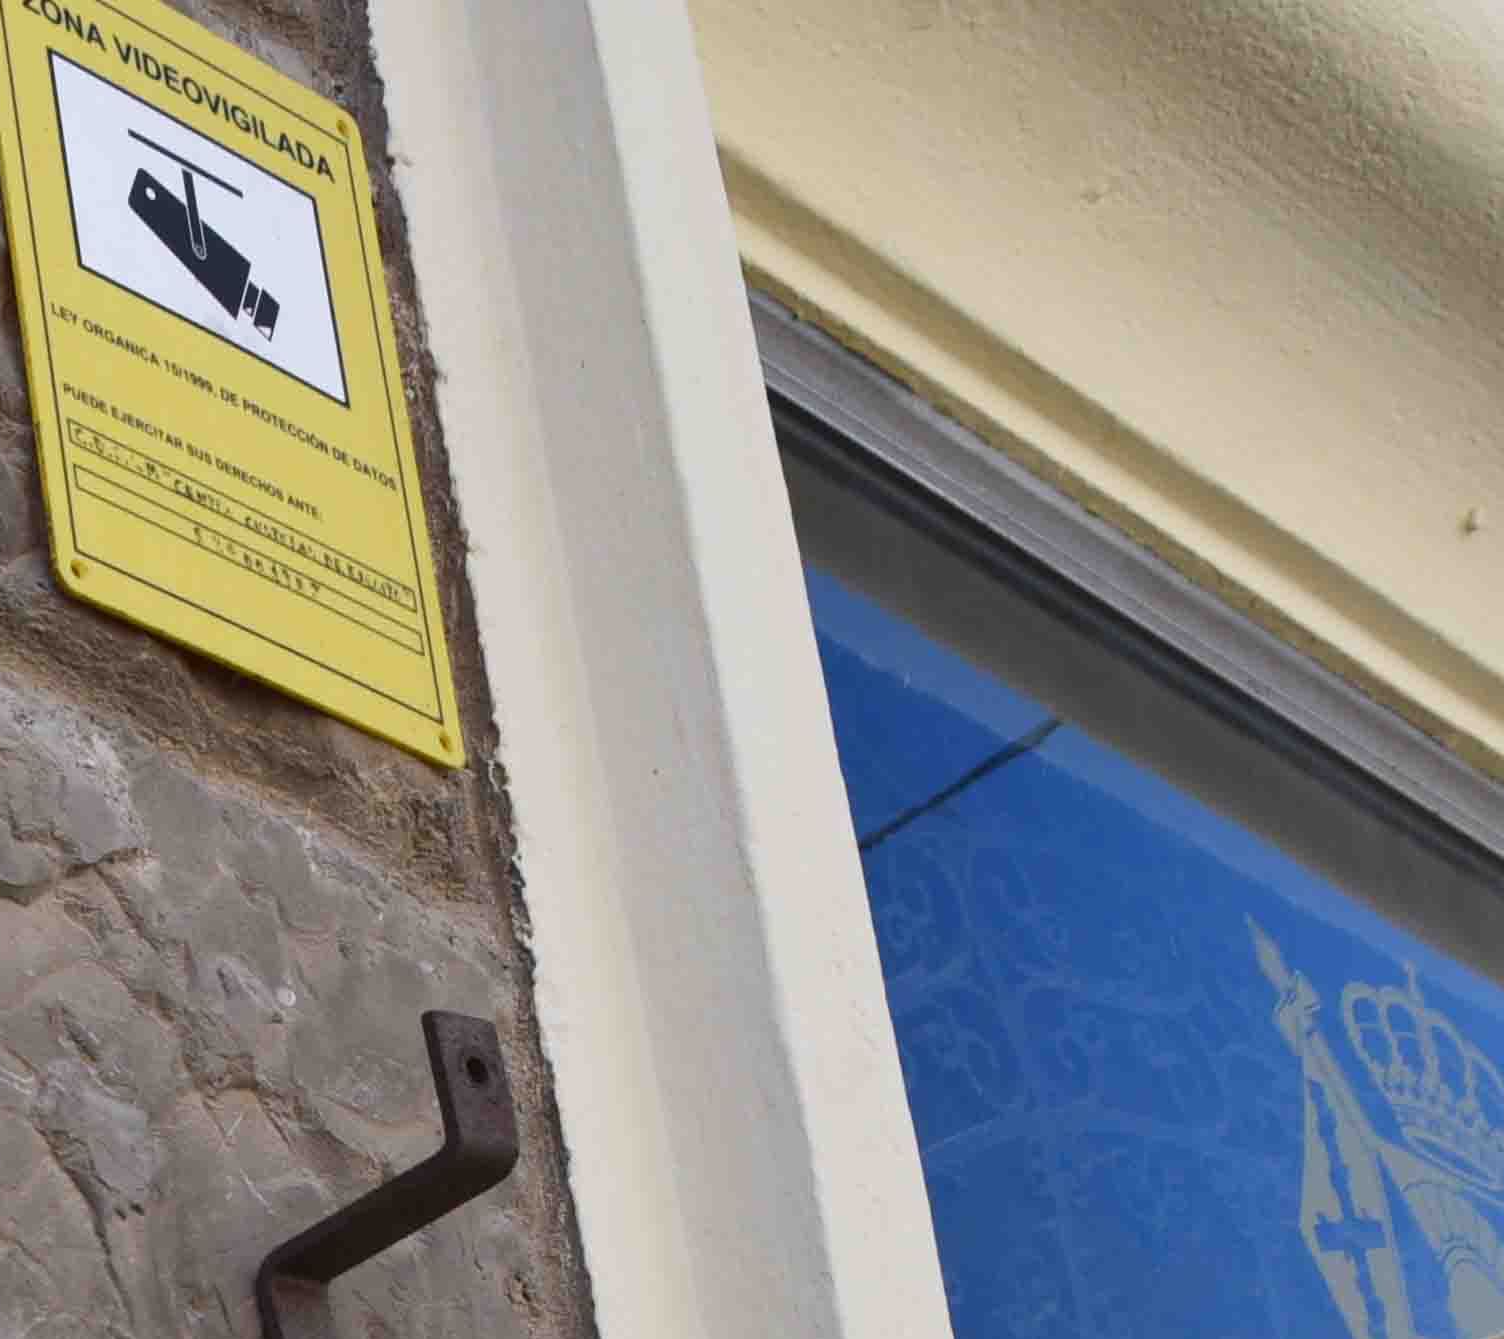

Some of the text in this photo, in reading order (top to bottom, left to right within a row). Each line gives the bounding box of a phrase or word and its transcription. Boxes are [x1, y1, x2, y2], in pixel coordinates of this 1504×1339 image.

[112, 32, 336, 185] VIDEOVIGILADA
[51, 302, 80, 328] LEY
[219, 386, 240, 407] DE
[242, 398, 331, 457] PROTECCIÓN
[332, 445, 352, 467] DE
[353, 455, 397, 492] DATOS
[63, 382, 108, 417] PUEDE
[111, 404, 184, 449] EJERCITAR
[186, 441, 213, 467] SUS
[216, 457, 285, 503] DERECHOS
